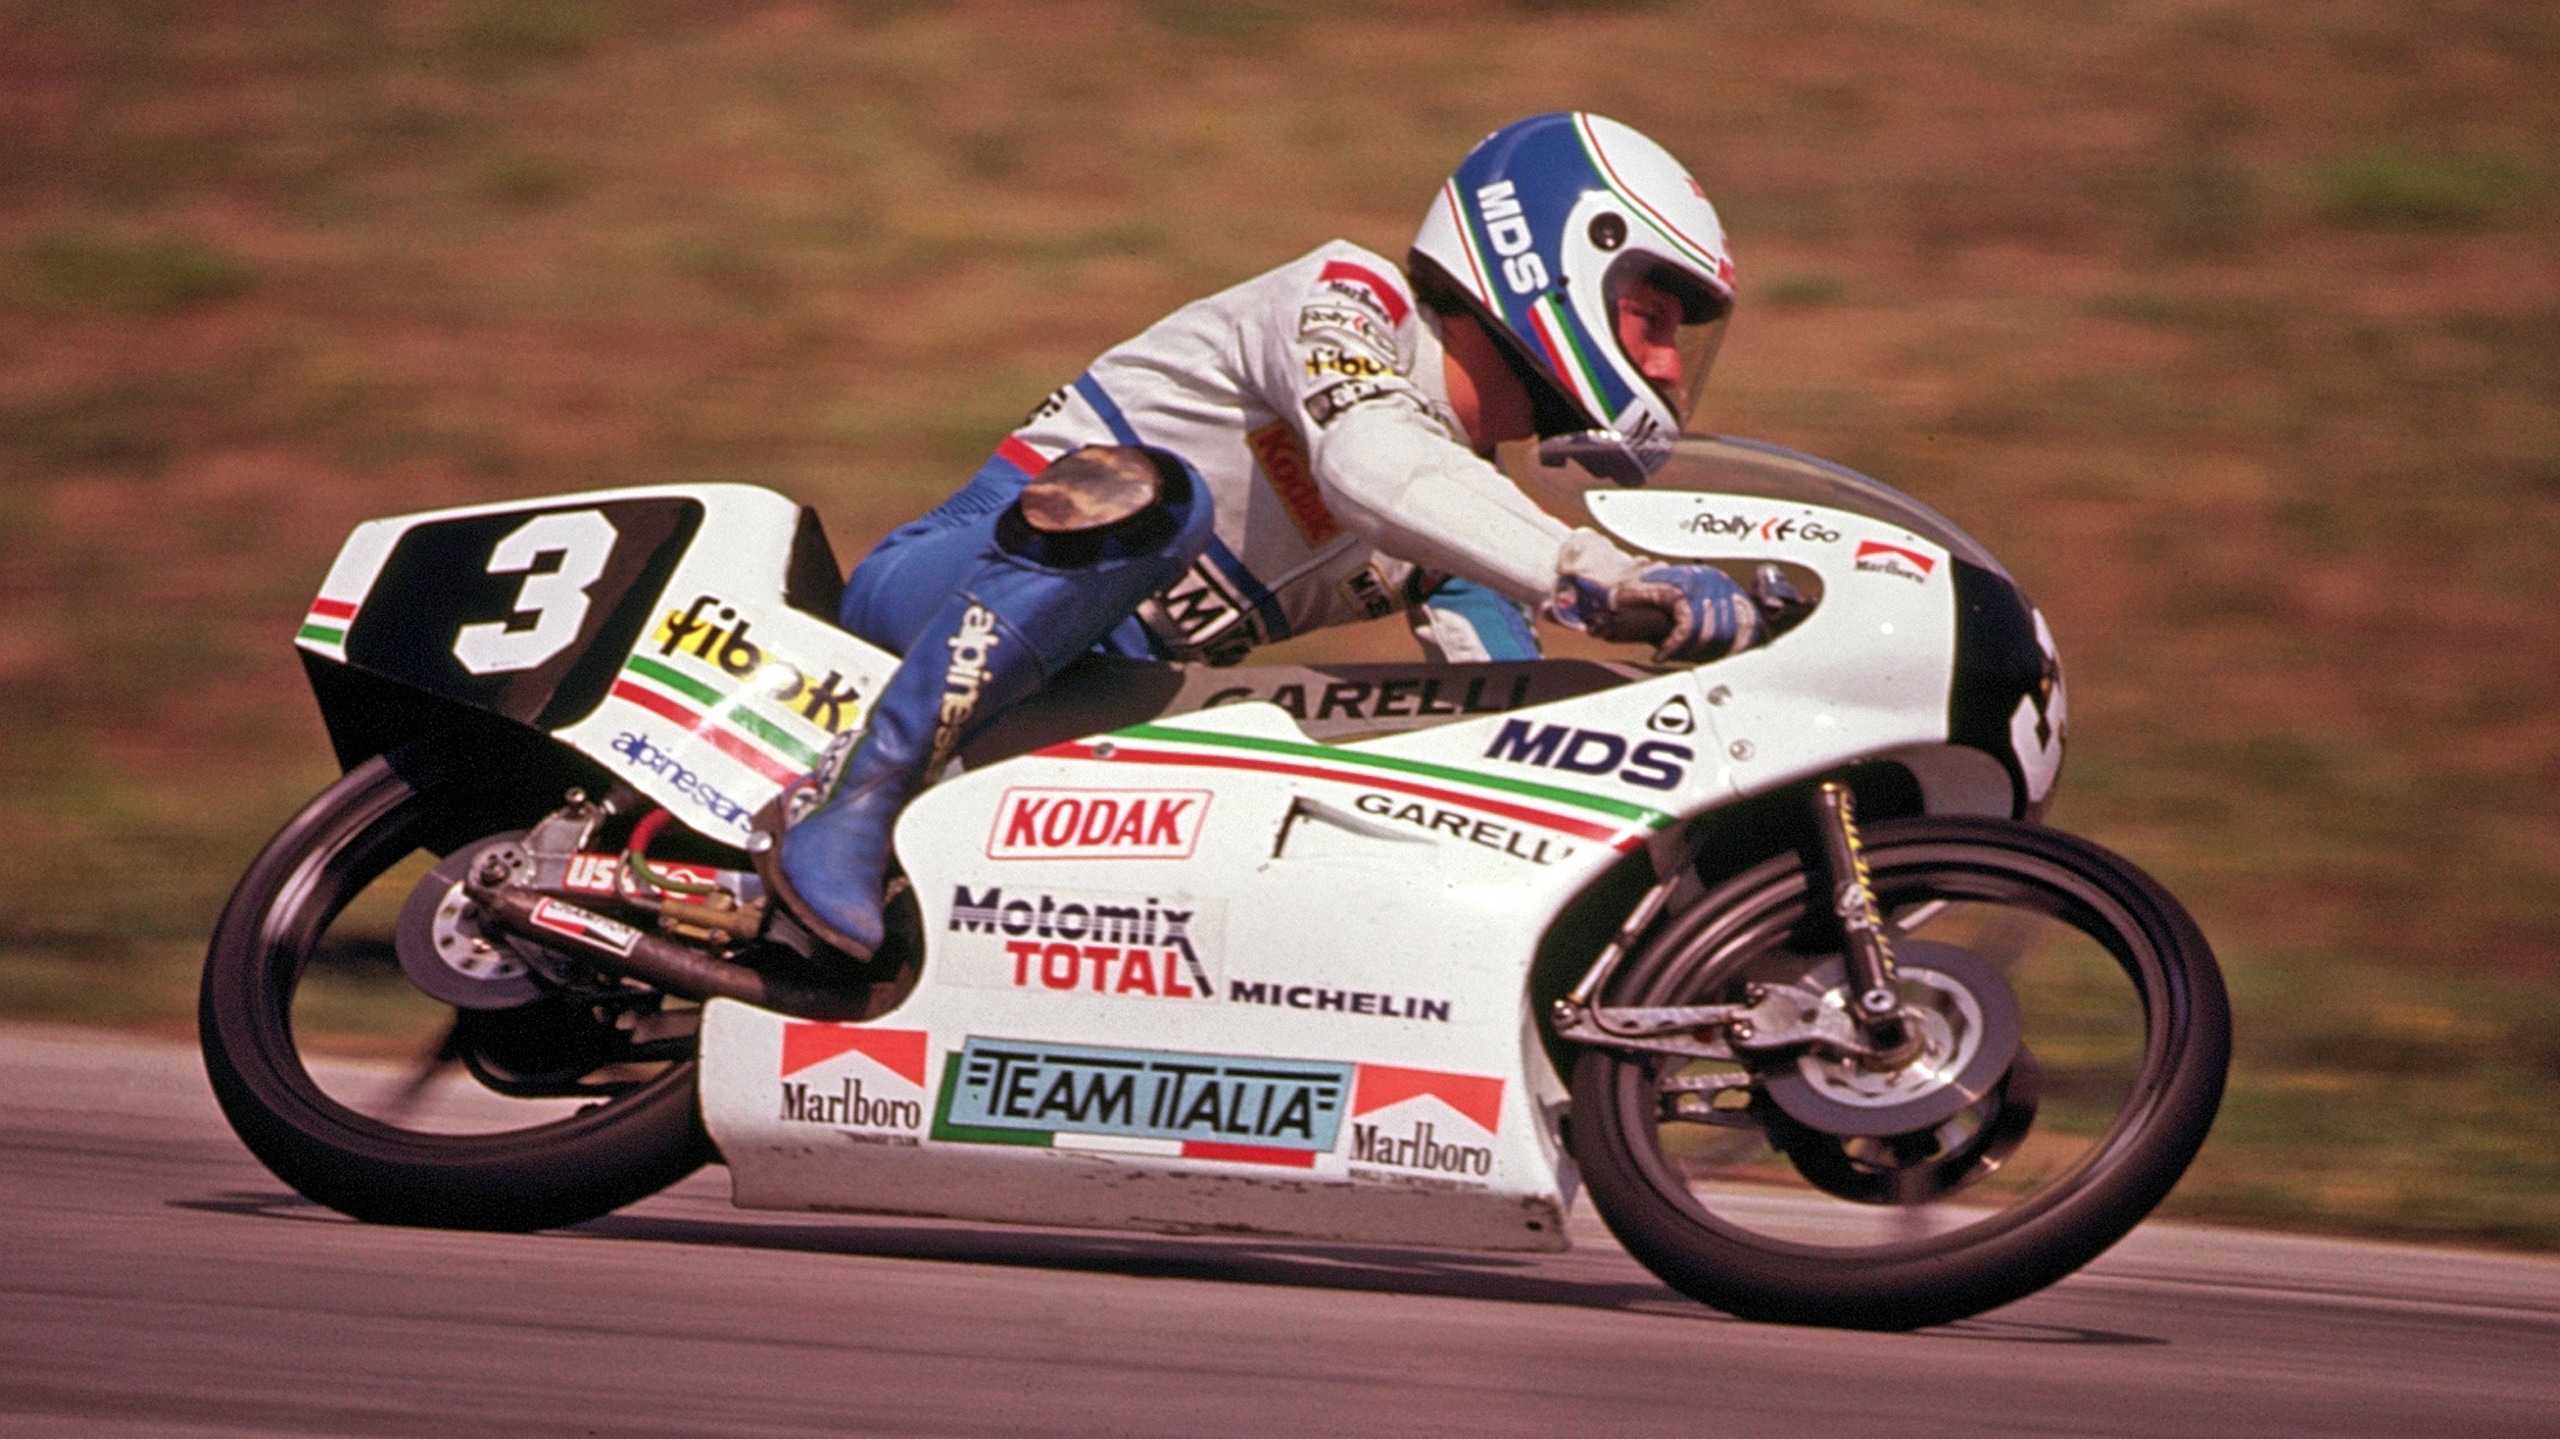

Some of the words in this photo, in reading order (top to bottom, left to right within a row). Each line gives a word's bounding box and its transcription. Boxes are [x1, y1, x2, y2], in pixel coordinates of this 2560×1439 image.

[1476, 179, 1549, 295] MDS
[1690, 512, 1757, 541] Rolly
[1799, 522, 1841, 543] Go
[453, 509, 618, 675] 3
[1483, 718, 1695, 791] MDS
[1003, 796, 1196, 849] KODAK
[949, 884, 1214, 999] Motomix
[1005, 940, 1193, 999] TOTAL
[1229, 979, 1452, 1023] MICHELIN
[780, 1076, 922, 1130] Marlboro
[972, 1048, 1144, 1127] TEAM
[1149, 1062, 1318, 1139] ITALIA
[1348, 1120, 1493, 1177] Marlboro
